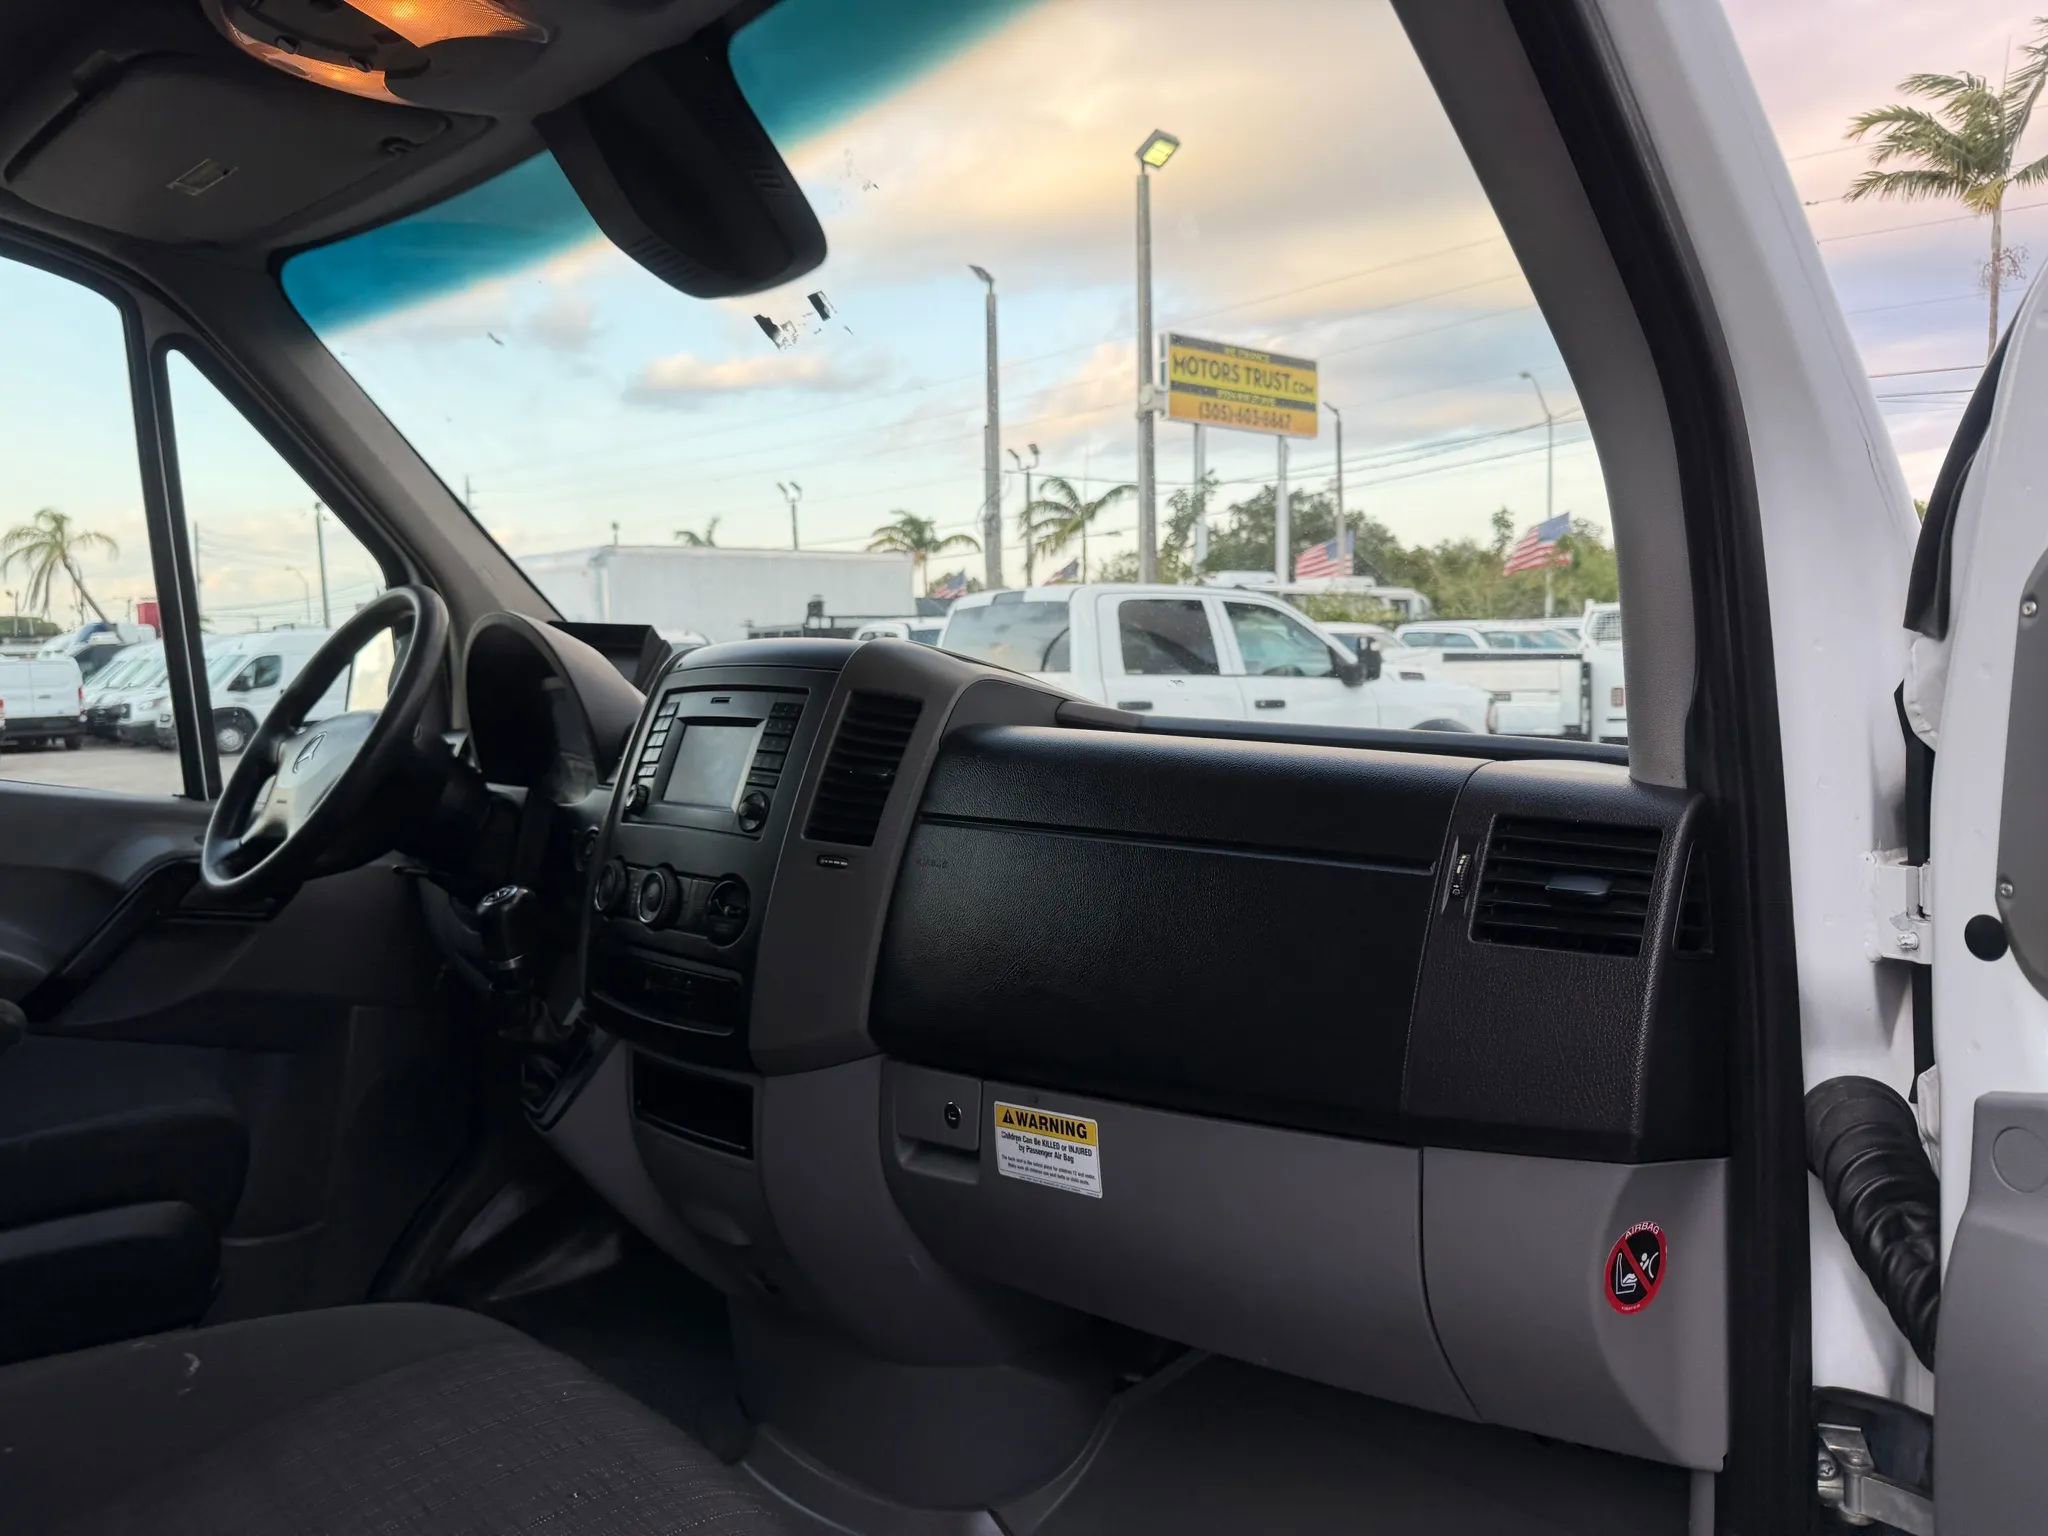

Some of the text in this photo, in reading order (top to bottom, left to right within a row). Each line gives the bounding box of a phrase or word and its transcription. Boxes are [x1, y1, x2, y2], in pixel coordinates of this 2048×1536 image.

[1173, 353, 1240, 383] MOTORS
[1015, 1111, 1088, 1139] WARNING
[1001, 1131, 1021, 1142] Children
[1022, 1135, 1032, 1143] Can
[1041, 1139, 1060, 1150] KILLED
[1068, 1145, 1092, 1157] INJURED
[1018, 1144, 1074, 1164] by Passenger Air Bag
[1625, 1222, 1659, 1240] AIRBAG
